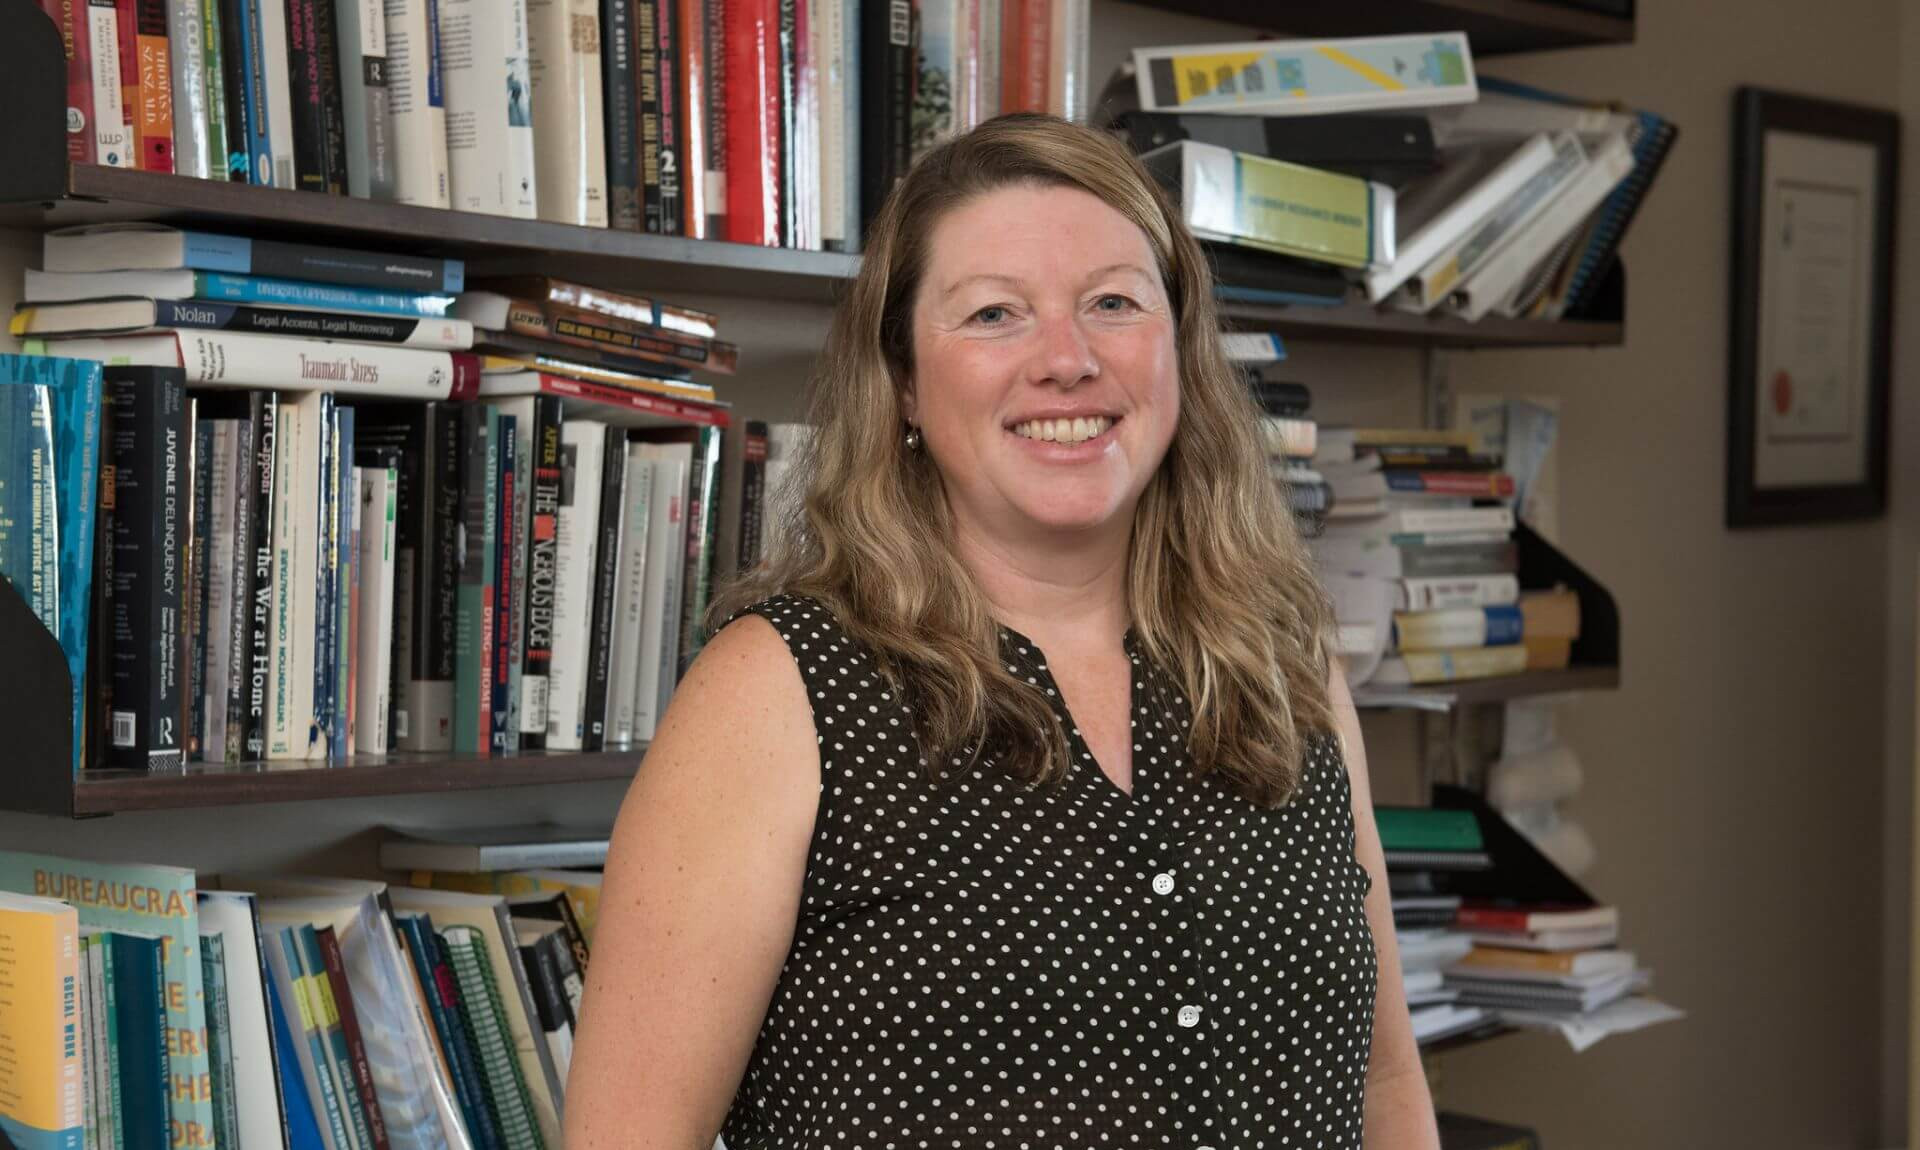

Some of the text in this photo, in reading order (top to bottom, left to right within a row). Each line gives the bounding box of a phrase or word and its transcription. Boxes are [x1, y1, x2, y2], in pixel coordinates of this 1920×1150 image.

[62, 0, 76, 60] OVERTY
[616, 28, 626, 70] GHOST
[156, 50, 168, 109] THOMAS
[144, 98, 156, 126] M.D.
[660, 150, 676, 172] 2
[174, 307, 217, 324] Nolan
[253, 314, 394, 336] Legal Accents, Legal Borrowing
[300, 353, 379, 384] Traumatic Stress
[172, 386, 180, 411] Third
[198, 432, 208, 465] Jack
[258, 402, 274, 494] Pat Capponi
[164, 427, 176, 596] JUVENILE DELINQUENCY
[486, 444, 497, 544] CATHY CROWE
[32, 448, 42, 592] YOUTH CRIMINAL JUSTICE ACT
[530, 484, 559, 646] THE NGEROUS EDGE
[44, 564, 53, 610] WORKING
[232, 498, 247, 700] DISPATCHES FROM THE POVERTY LINE
[252, 546, 272, 717] the War at Home
[481, 606, 492, 713] DYING HOME
[63, 976, 76, 1018] SOCIAL
[64, 1024, 76, 1058] WORK
[159, 1014, 168, 1046] REVIEW
[358, 1061, 368, 1086] CALL
